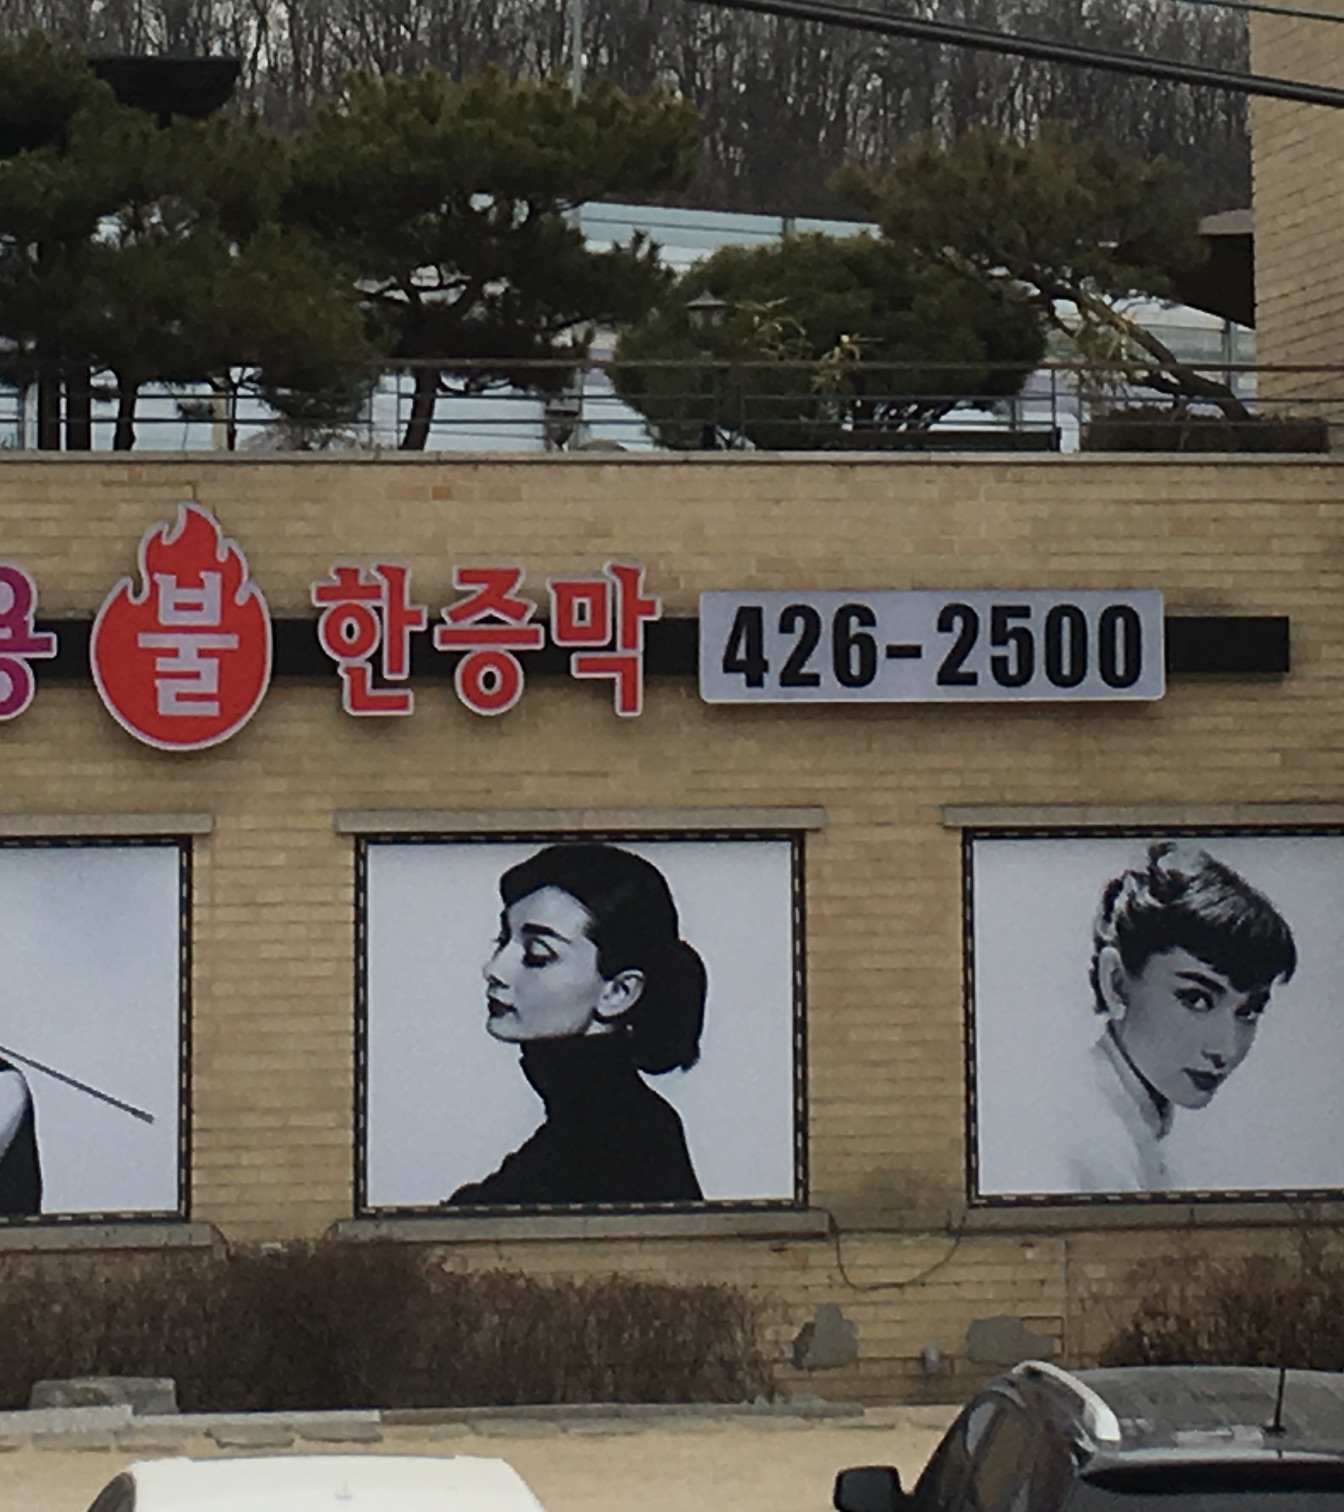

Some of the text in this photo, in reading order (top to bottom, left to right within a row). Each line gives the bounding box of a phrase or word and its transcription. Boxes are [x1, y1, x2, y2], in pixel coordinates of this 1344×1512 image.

[136, 572, 239, 716] 불
[310, 561, 661, 717] 한증막
[721, 604, 1145, 690] 426-2500
